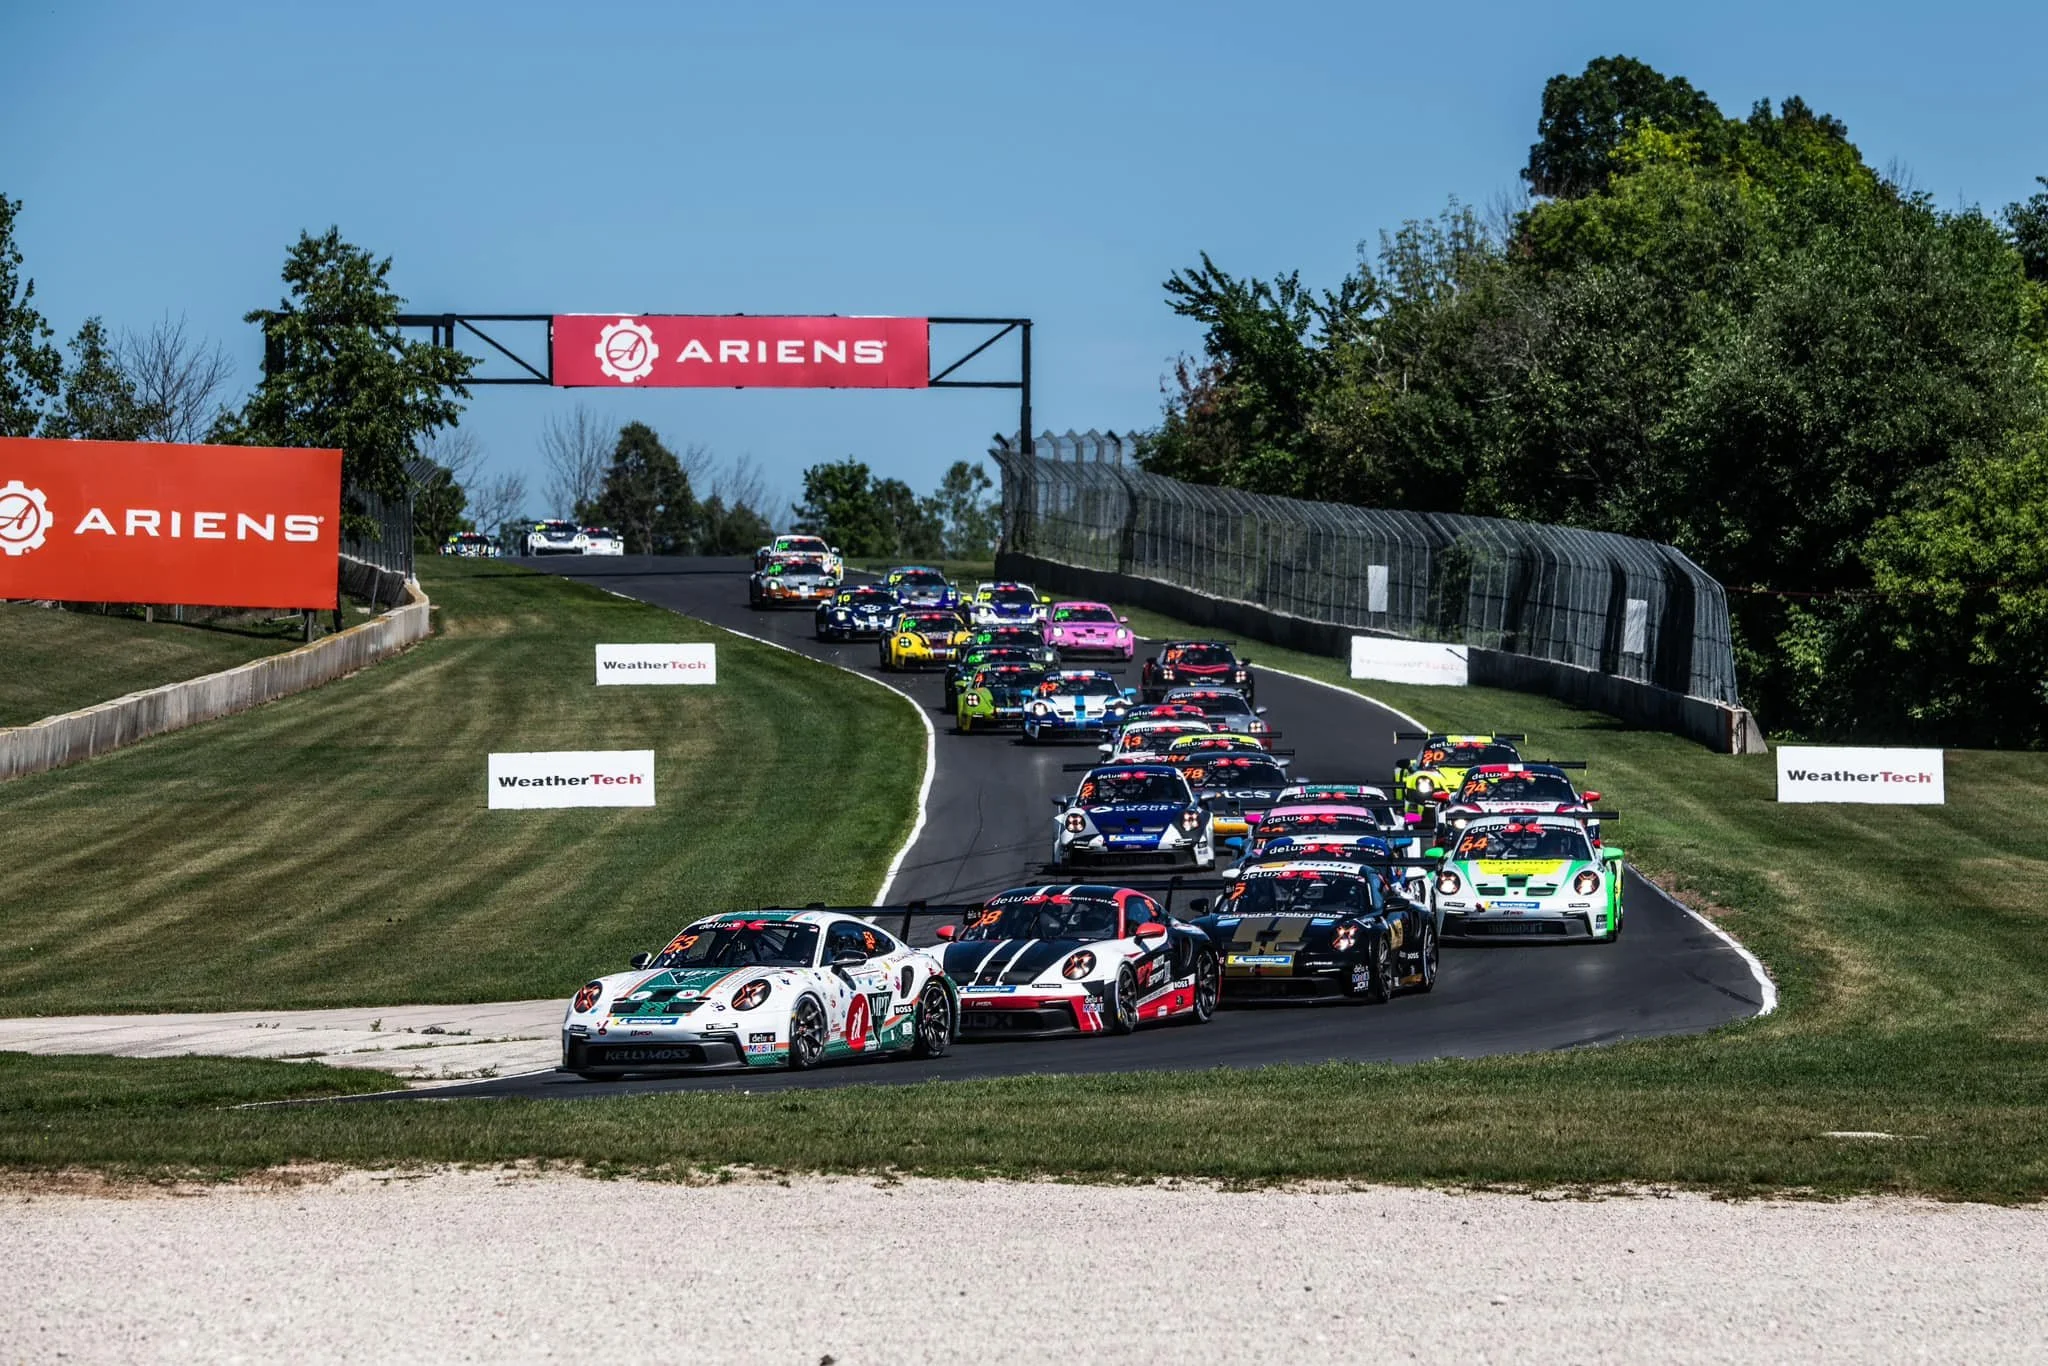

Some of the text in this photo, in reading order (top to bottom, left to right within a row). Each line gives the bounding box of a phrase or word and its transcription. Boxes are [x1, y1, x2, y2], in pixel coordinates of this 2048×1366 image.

[676, 339, 885, 364] ARIENS
[74, 507, 319, 542] ARIENS
[603, 661, 707, 670] WeatherTech
[498, 774, 643, 788] WeatherTech
[1471, 771, 1511, 781] deluxe
[1787, 770, 1932, 784] WeatherTech
[1267, 814, 1311, 825] deluxe
[1471, 823, 1516, 834] deluxe
[1269, 844, 1315, 855] deluxe
[1241, 870, 1291, 881] deluxe
[990, 894, 1042, 906] deluxe
[698, 921, 743, 931] deluxe
[894, 1005, 913, 1015] BOSS
